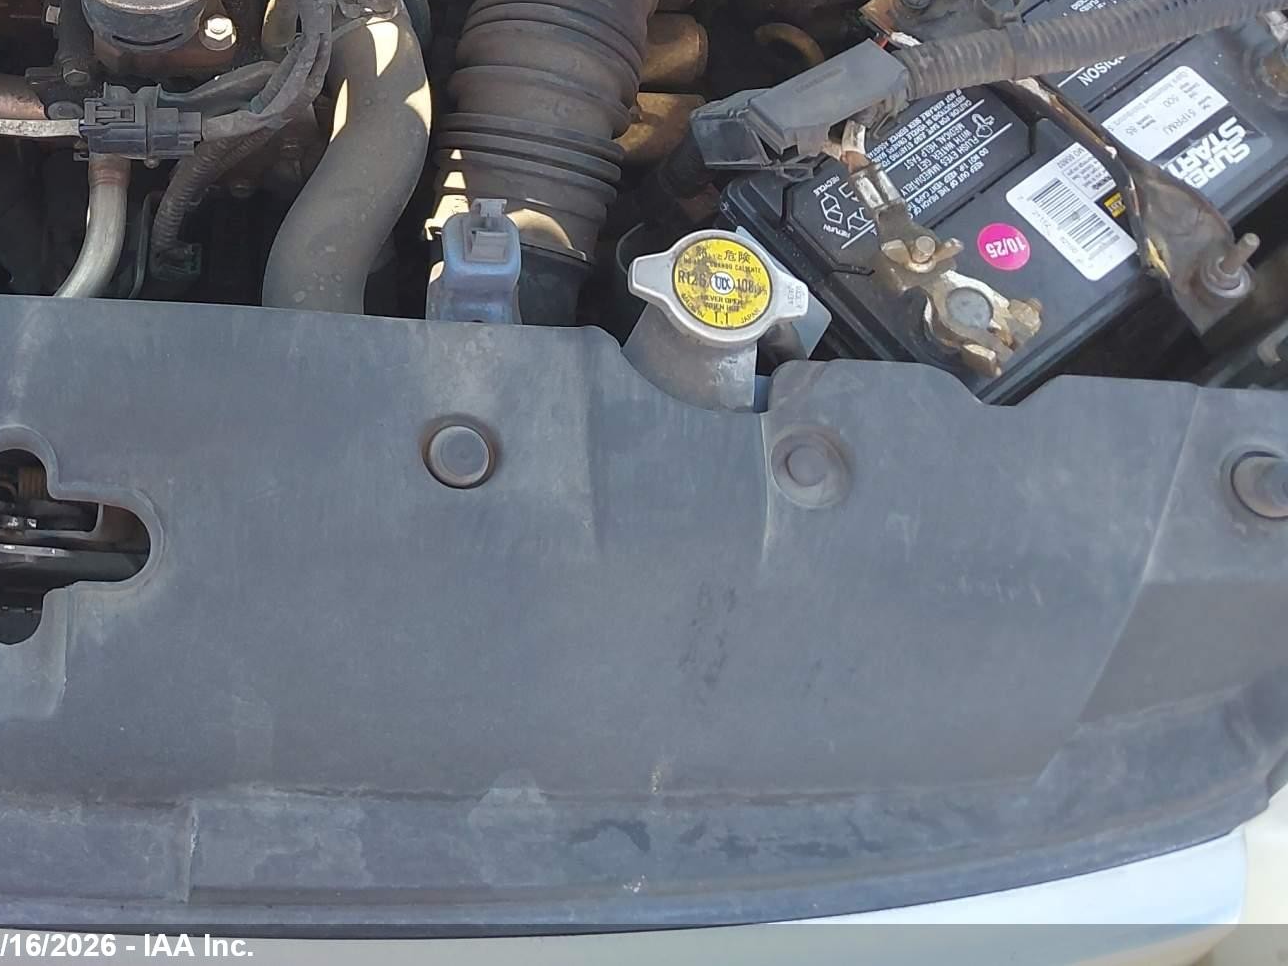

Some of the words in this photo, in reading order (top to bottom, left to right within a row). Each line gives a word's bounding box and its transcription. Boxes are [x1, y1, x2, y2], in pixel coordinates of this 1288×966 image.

[935, 122, 964, 144] MEDICAL
[952, 128, 972, 144] WITH
[919, 141, 937, 157] HELP
[955, 135, 980, 154] FLUSH
[977, 147, 988, 156] DO
[902, 153, 921, 169] FAST
[916, 157, 932, 171] GET
[939, 150, 959, 167] EYES
[967, 153, 980, 164] NOT
[899, 162, 942, 196] IMMEDIATELY
[948, 178, 959, 188] OF
[956, 170, 970, 182] OUT
[812, 174, 840, 196] RECYCLE
[928, 180, 944, 193] VENT
[936, 185, 950, 196] THE
[913, 190, 930, 204] CAPS
[985, 233, 1027, 263] 10/25
[714, 312, 729, 325] 1.1
